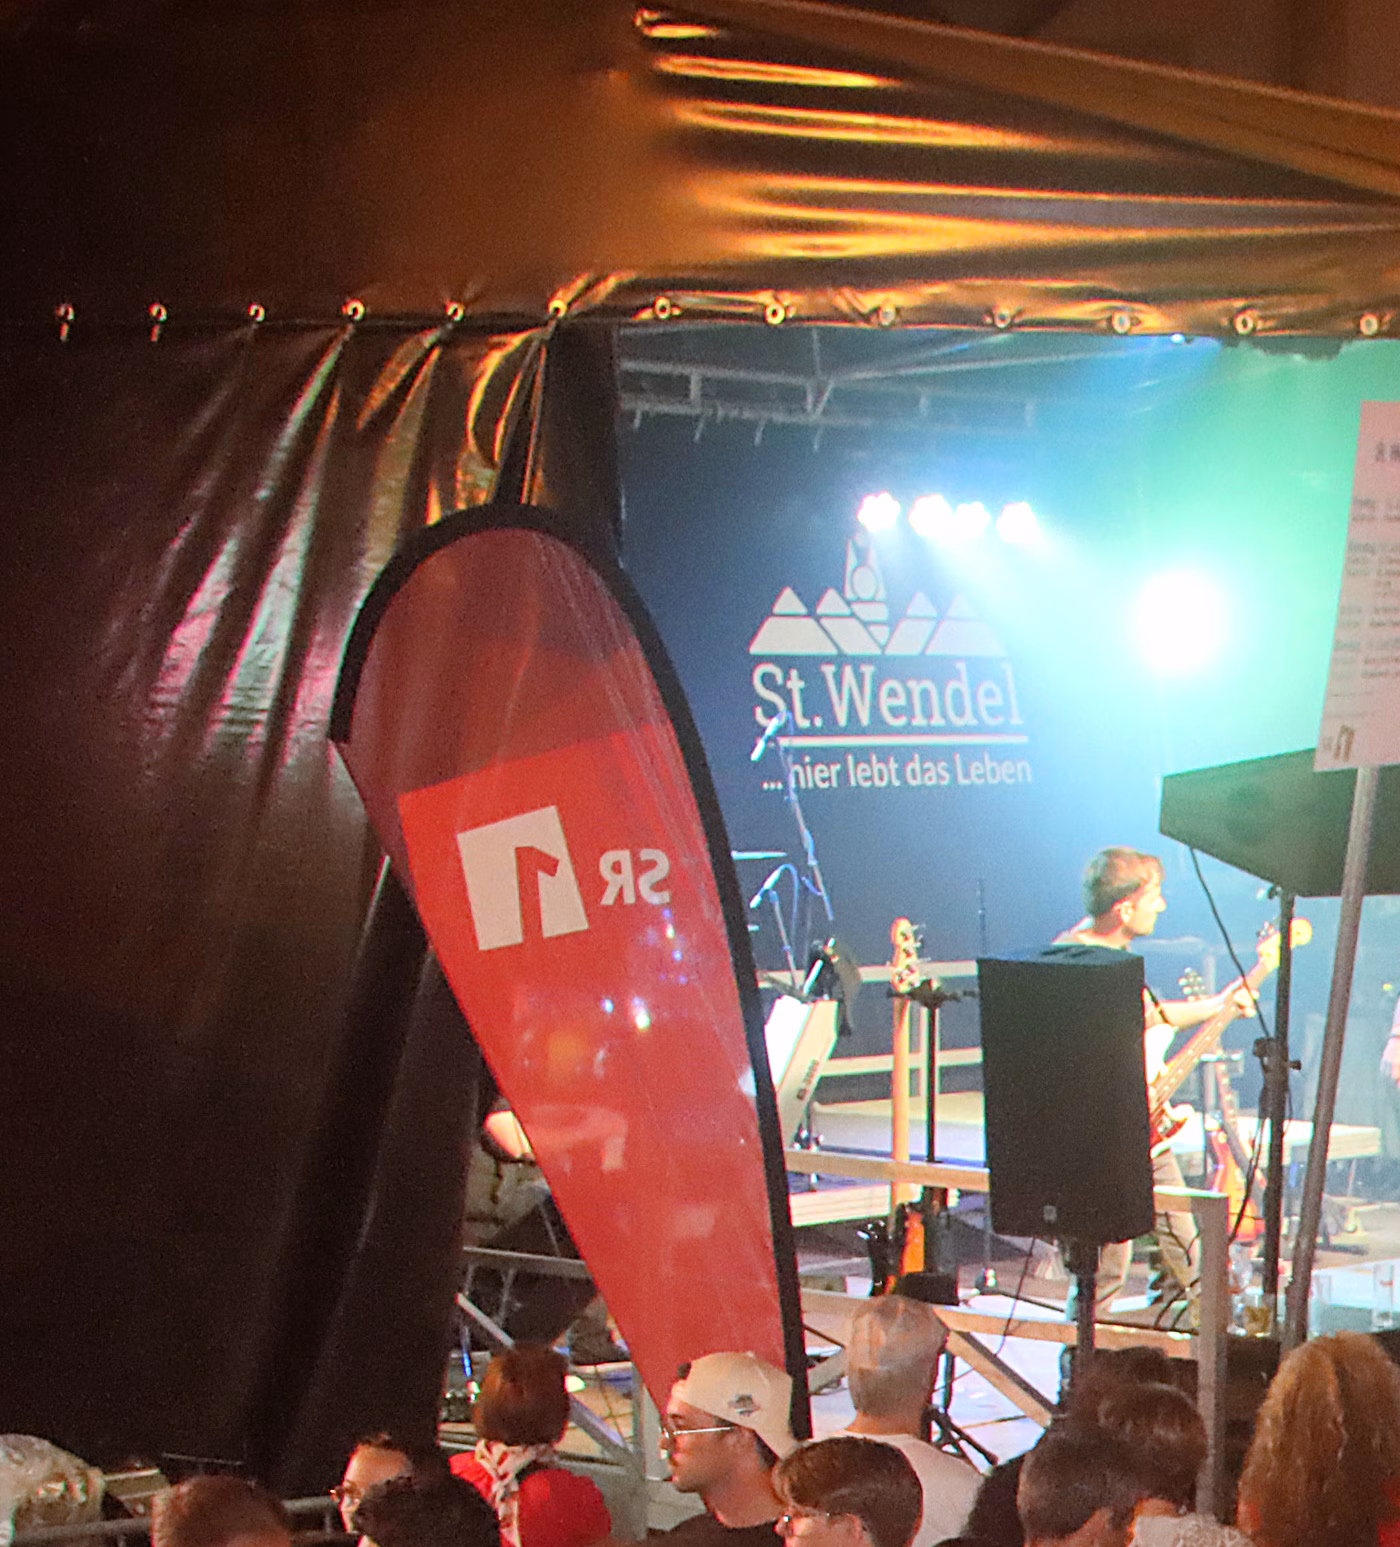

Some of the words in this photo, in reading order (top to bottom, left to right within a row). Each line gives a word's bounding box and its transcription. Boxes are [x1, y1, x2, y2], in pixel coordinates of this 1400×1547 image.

[846, 754, 900, 788] lebt
[905, 753, 951, 788] das
[954, 752, 1033, 787] Leben
